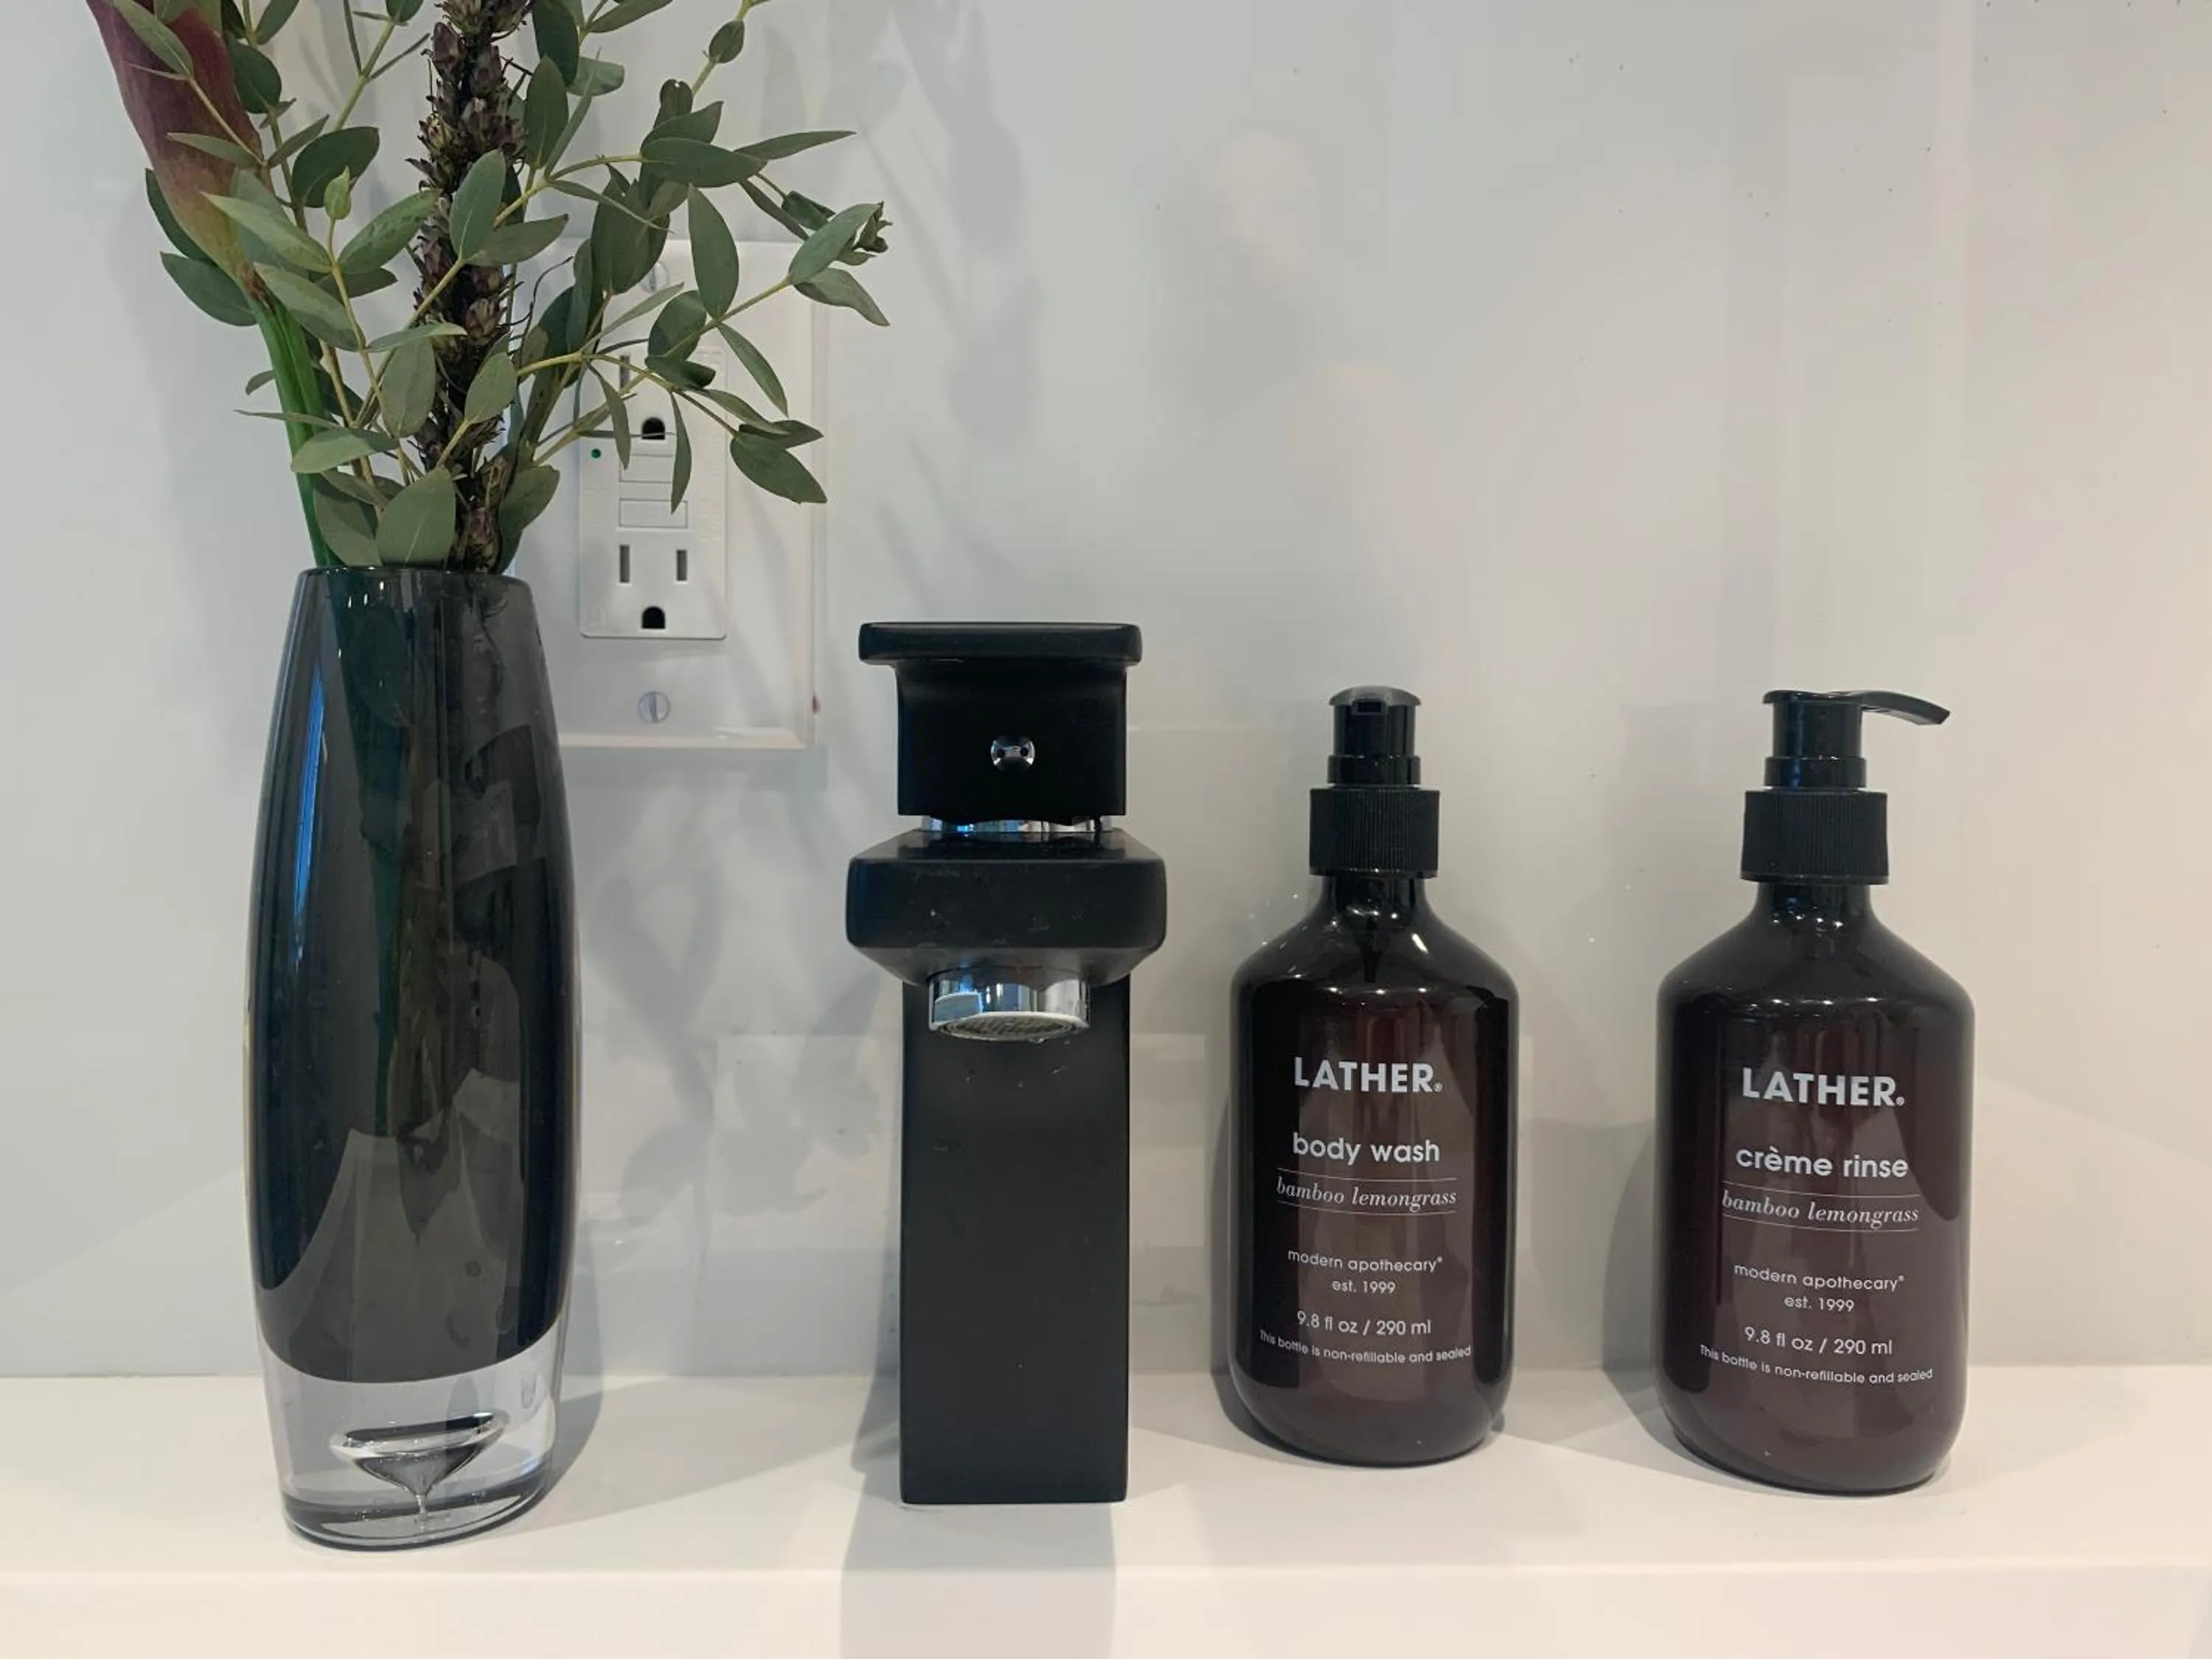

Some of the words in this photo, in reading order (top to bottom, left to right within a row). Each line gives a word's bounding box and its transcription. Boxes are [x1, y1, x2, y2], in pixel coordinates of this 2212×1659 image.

[1293, 1133, 1361, 1166] body
[1370, 1140, 1439, 1162] wash
[1736, 1146, 1833, 1176] crème
[1843, 1155, 1908, 1178] rinse
[1276, 1177, 1344, 1203] bamboo
[1352, 1187, 1457, 1212] lemongrass
[1722, 1190, 1800, 1218] bamboo
[1807, 1202, 1919, 1229] lemongrass
[1288, 1251, 1343, 1269] modern
[1734, 1264, 1796, 1284] modern
[1332, 1281, 1357, 1292] est.
[1363, 1281, 1395, 1293] 1999
[1784, 1296, 1812, 1310] est.
[1819, 1298, 1854, 1312] 1999
[1297, 1311, 1319, 1328] 9.8
[1325, 1317, 1332, 1329] fl
[1339, 1321, 1357, 1333] oz
[1363, 1321, 1371, 1335] /
[1377, 1321, 1406, 1335] 290
[1411, 1321, 1431, 1334] ml
[1259, 1329, 1276, 1346] This
[1278, 1338, 1308, 1354] bottle
[1312, 1346, 1320, 1356] is
[1324, 1349, 1405, 1363] non-refillable
[1409, 1350, 1433, 1363] and
[1436, 1345, 1471, 1361] sealed
[1745, 1326, 1770, 1344] 9.8
[1776, 1333, 1785, 1347] fl
[1791, 1338, 1813, 1352] oz
[1819, 1338, 1828, 1354] /
[1834, 1339, 1866, 1354] 290
[1871, 1340, 1892, 1355] ml
[1700, 1345, 1719, 1360] This
[1722, 1352, 1757, 1370] bottle
[1761, 1363, 1770, 1374] is
[1775, 1366, 1865, 1384] non-refillable
[1869, 1372, 1893, 1383] and
[1898, 1368, 1933, 1383] sealed
